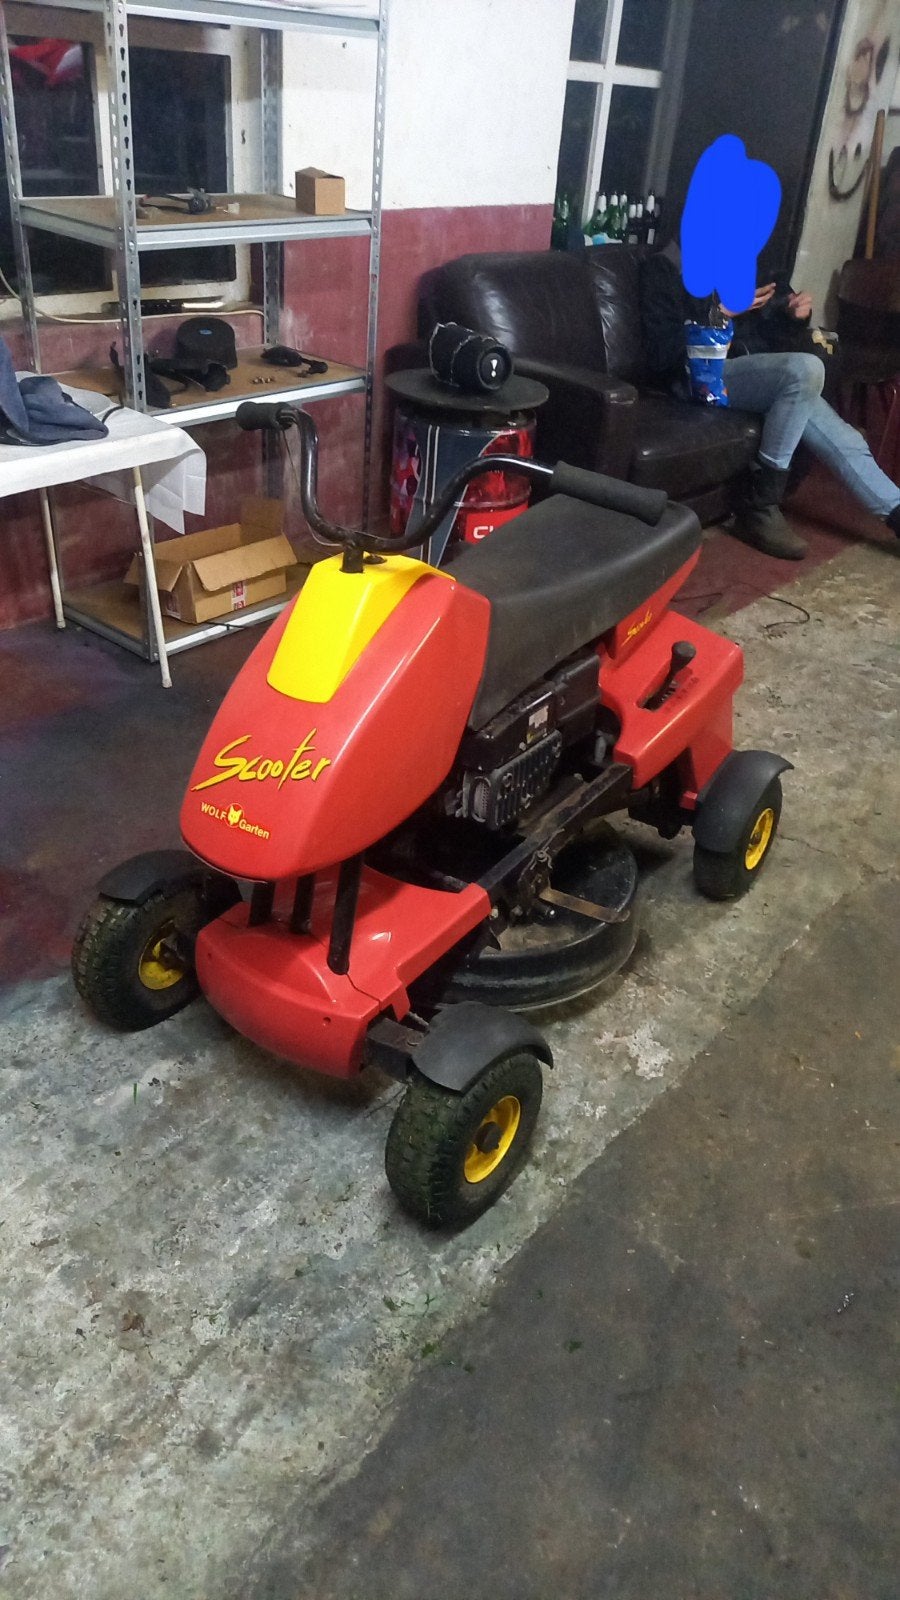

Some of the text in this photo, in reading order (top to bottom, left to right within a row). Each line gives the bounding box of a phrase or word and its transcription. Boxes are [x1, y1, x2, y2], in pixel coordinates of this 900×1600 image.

[190, 727, 331, 791] Scooter
[201, 801, 270, 839] WOLF Garten
